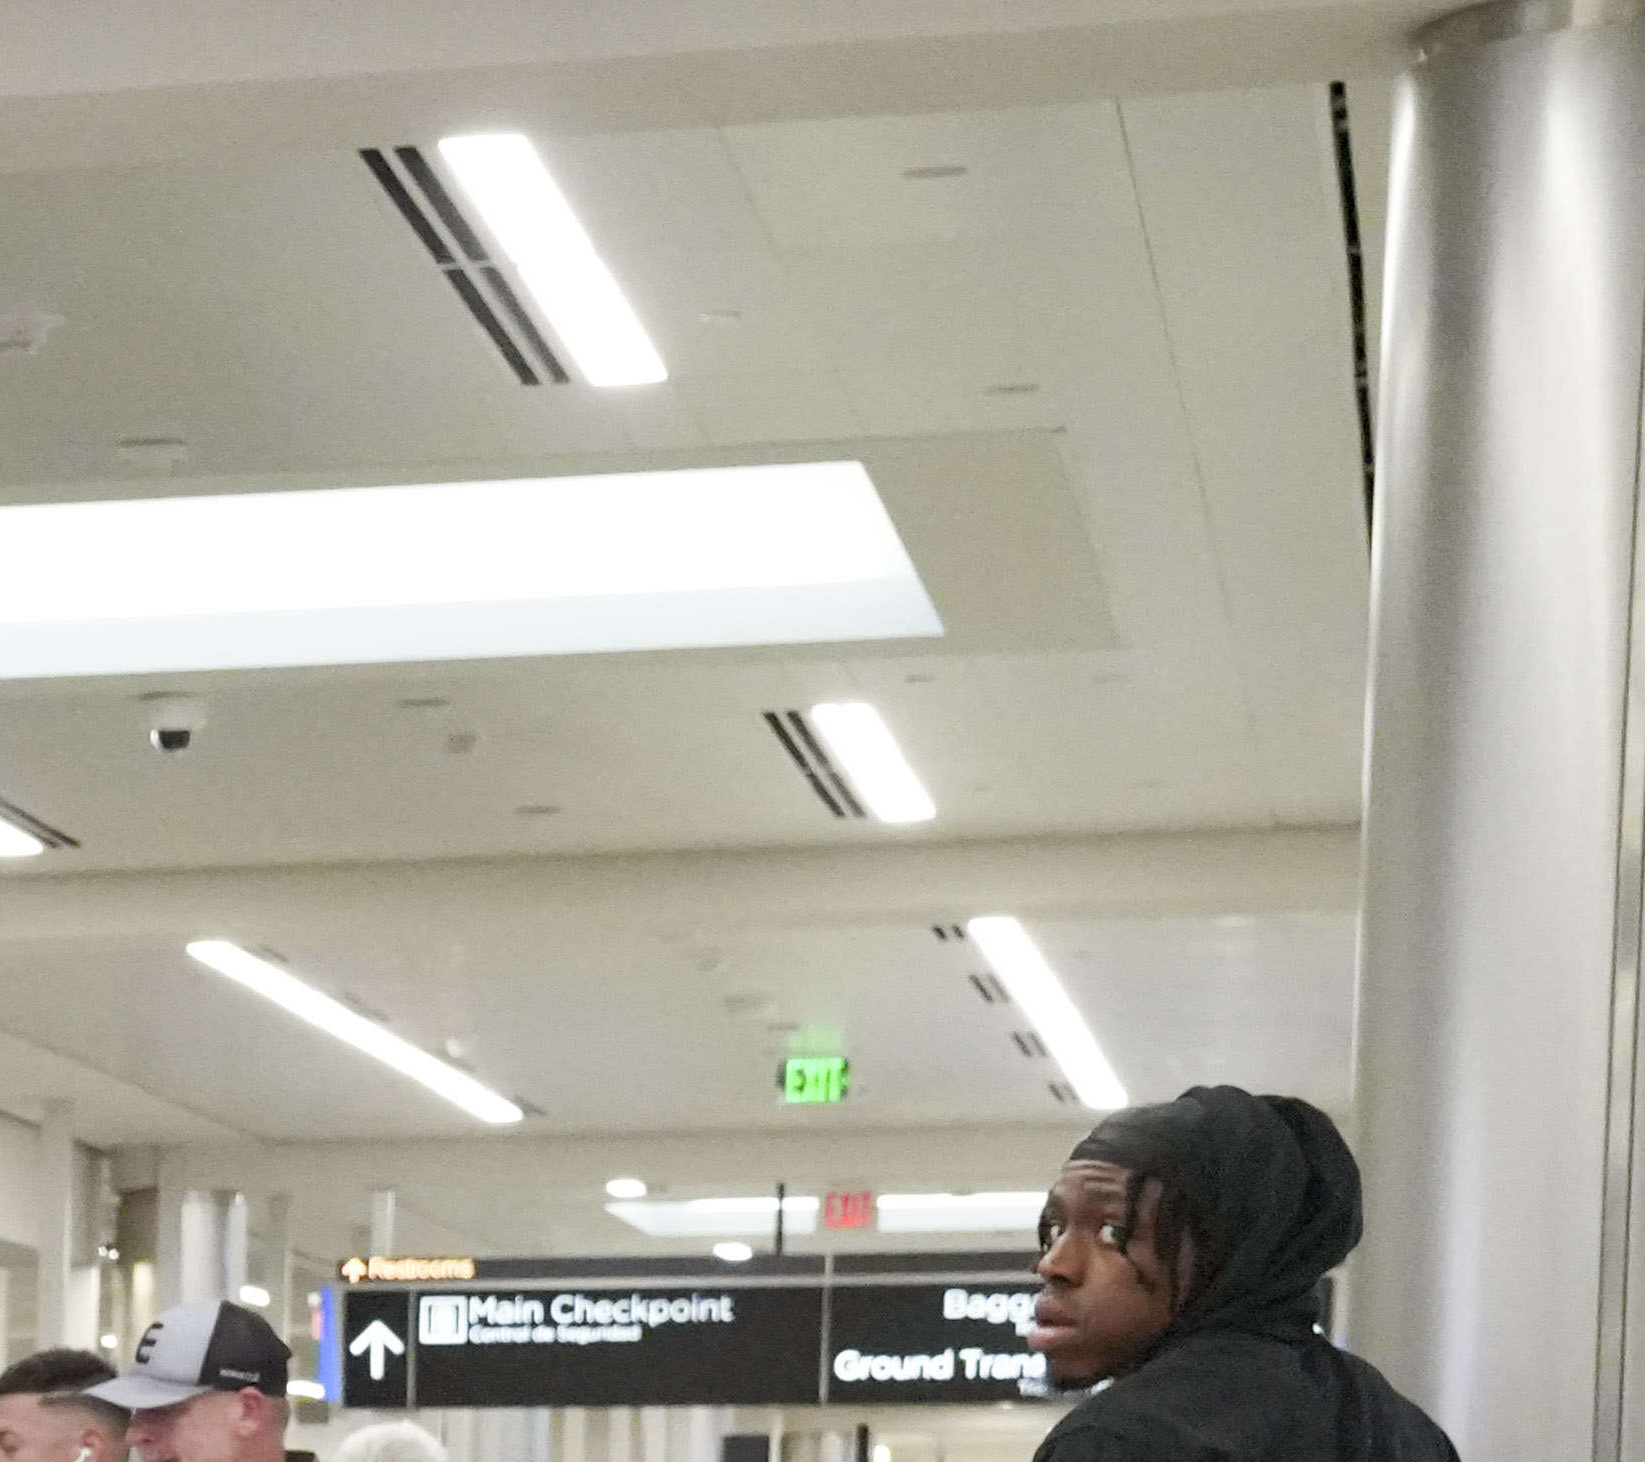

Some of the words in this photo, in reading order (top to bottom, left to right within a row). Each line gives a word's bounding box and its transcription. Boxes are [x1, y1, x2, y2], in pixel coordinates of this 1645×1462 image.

[369, 1256, 475, 1280] Restrooms
[469, 1295, 544, 1325] Main
[551, 1294, 734, 1327] Checkpoint
[834, 1348, 955, 1381] Ground
[959, 1347, 1048, 1379] Trans
